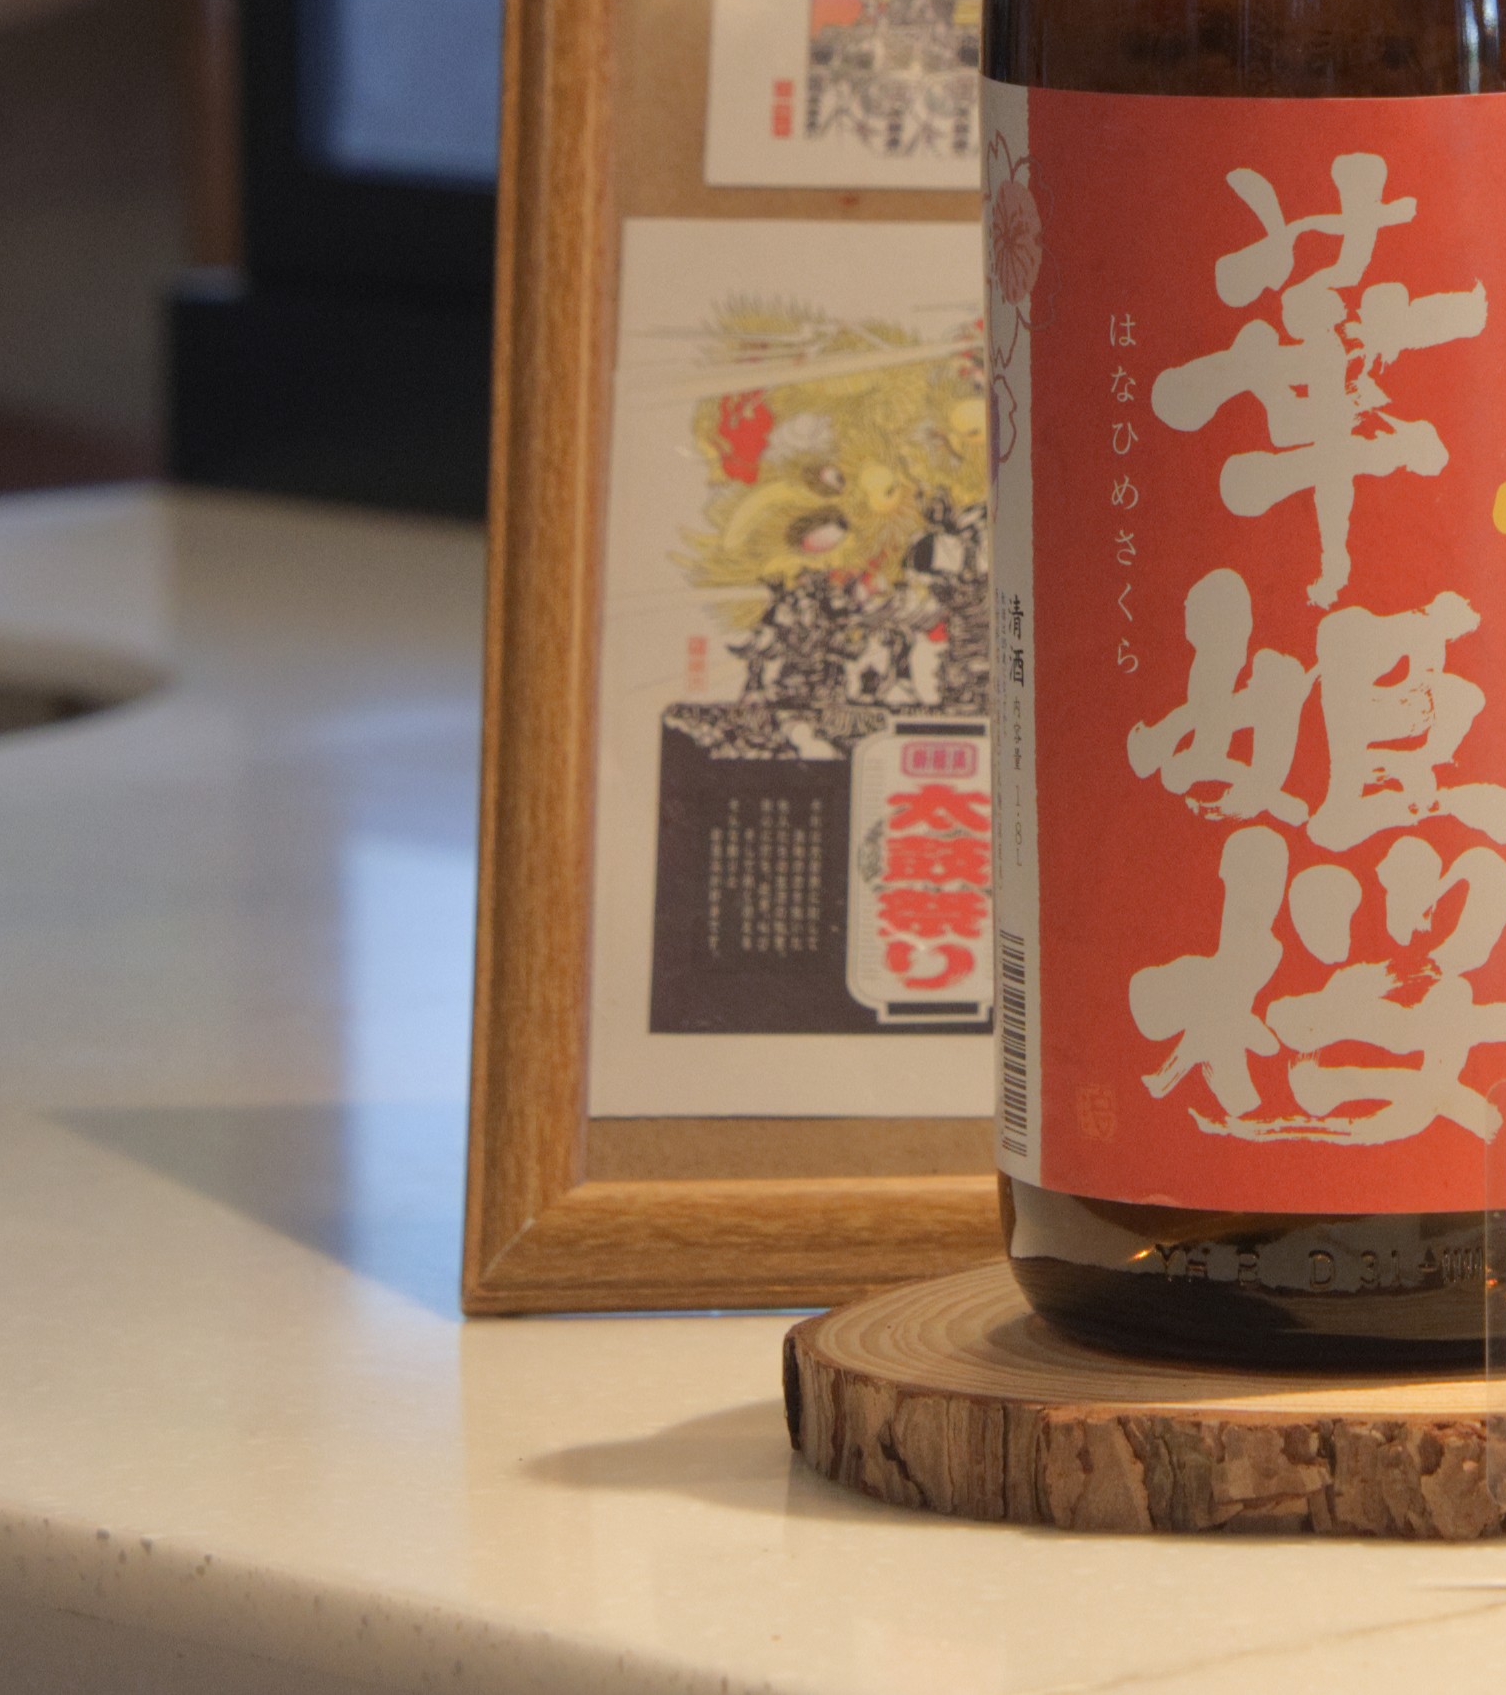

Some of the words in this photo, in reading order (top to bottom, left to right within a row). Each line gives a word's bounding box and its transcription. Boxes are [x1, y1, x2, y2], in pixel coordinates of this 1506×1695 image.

[1108, 312, 1142, 676] はなひめさくら
[1007, 594, 1025, 687] 清酒
